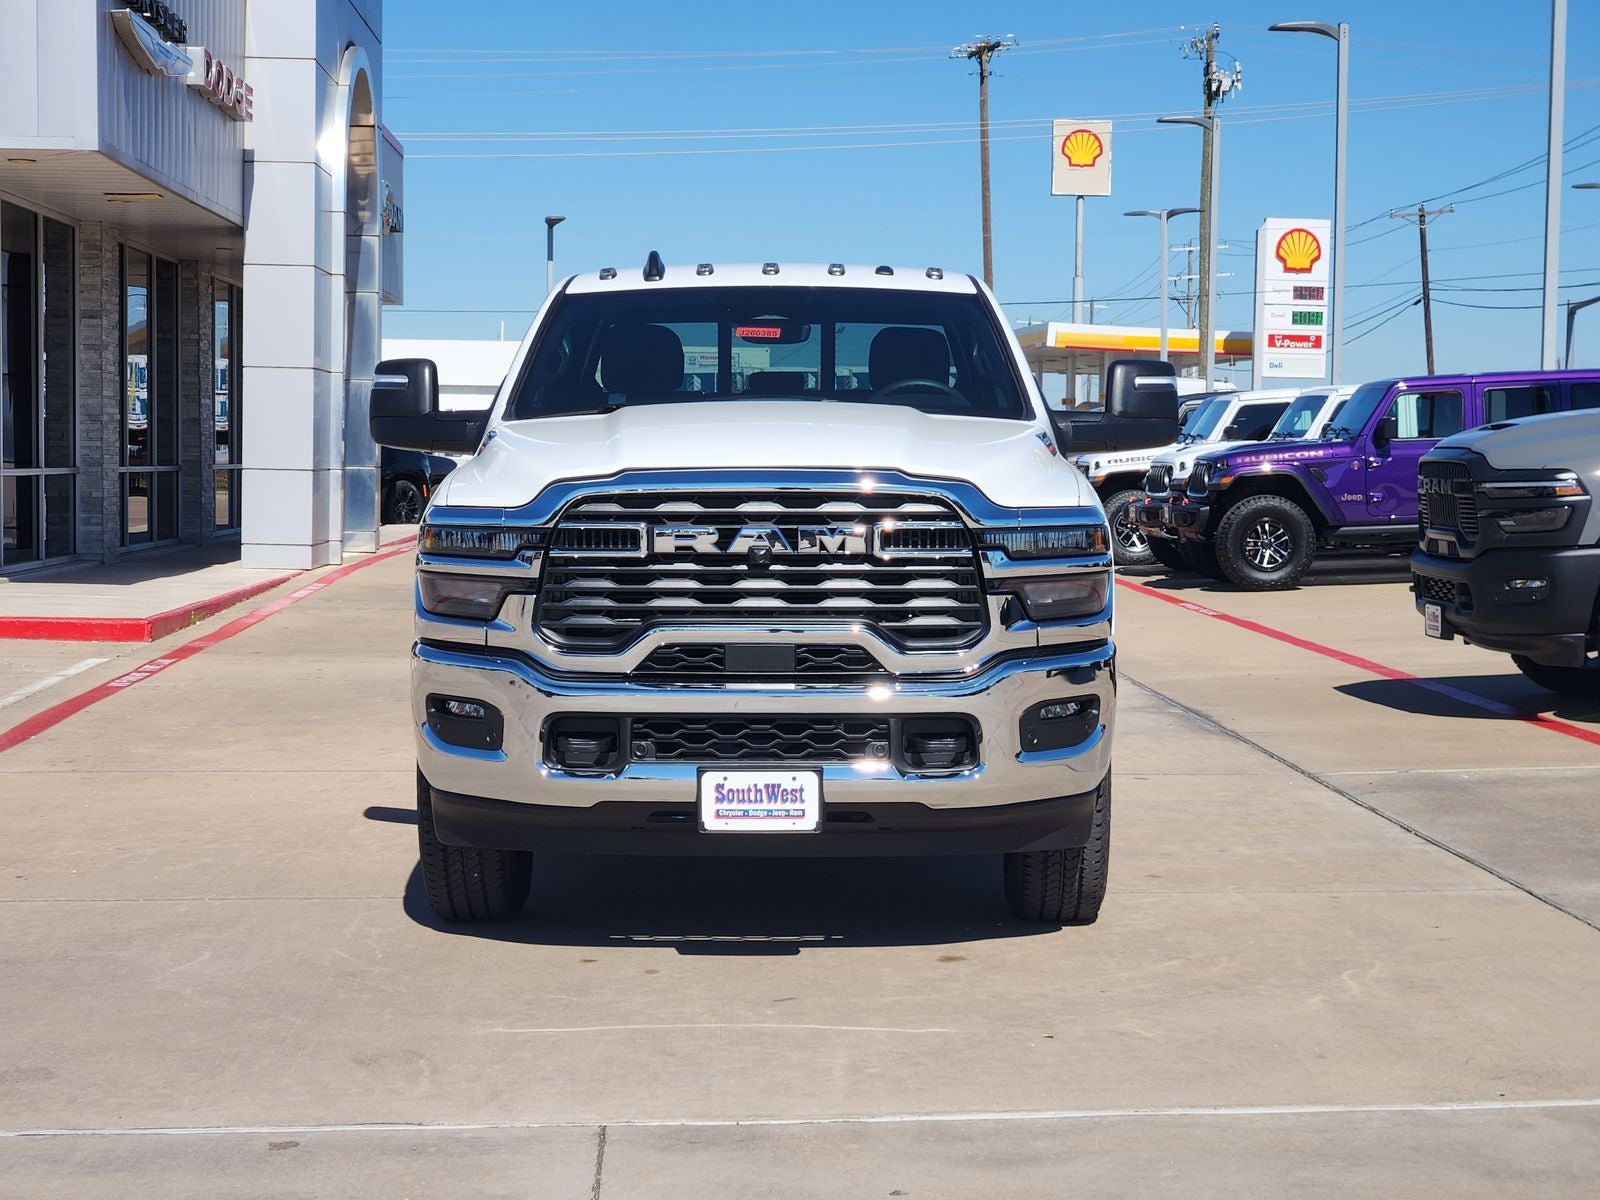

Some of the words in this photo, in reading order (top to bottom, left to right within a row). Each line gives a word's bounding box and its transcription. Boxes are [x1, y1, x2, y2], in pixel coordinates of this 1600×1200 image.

[202, 47, 254, 122] DODGE
[1274, 339, 1314, 348] V-Power
[1269, 361, 1283, 369] Deli
[1236, 451, 1324, 463] RUBICON
[1423, 478, 1453, 495] RAM
[1341, 493, 1363, 503] Jeep
[653, 525, 867, 554] RAM
[714, 782, 805, 805] SouthWest
[718, 809, 744, 817] Chrysler
[748, 809, 768, 818] Dodge
[771, 809, 786, 817] Jeep
